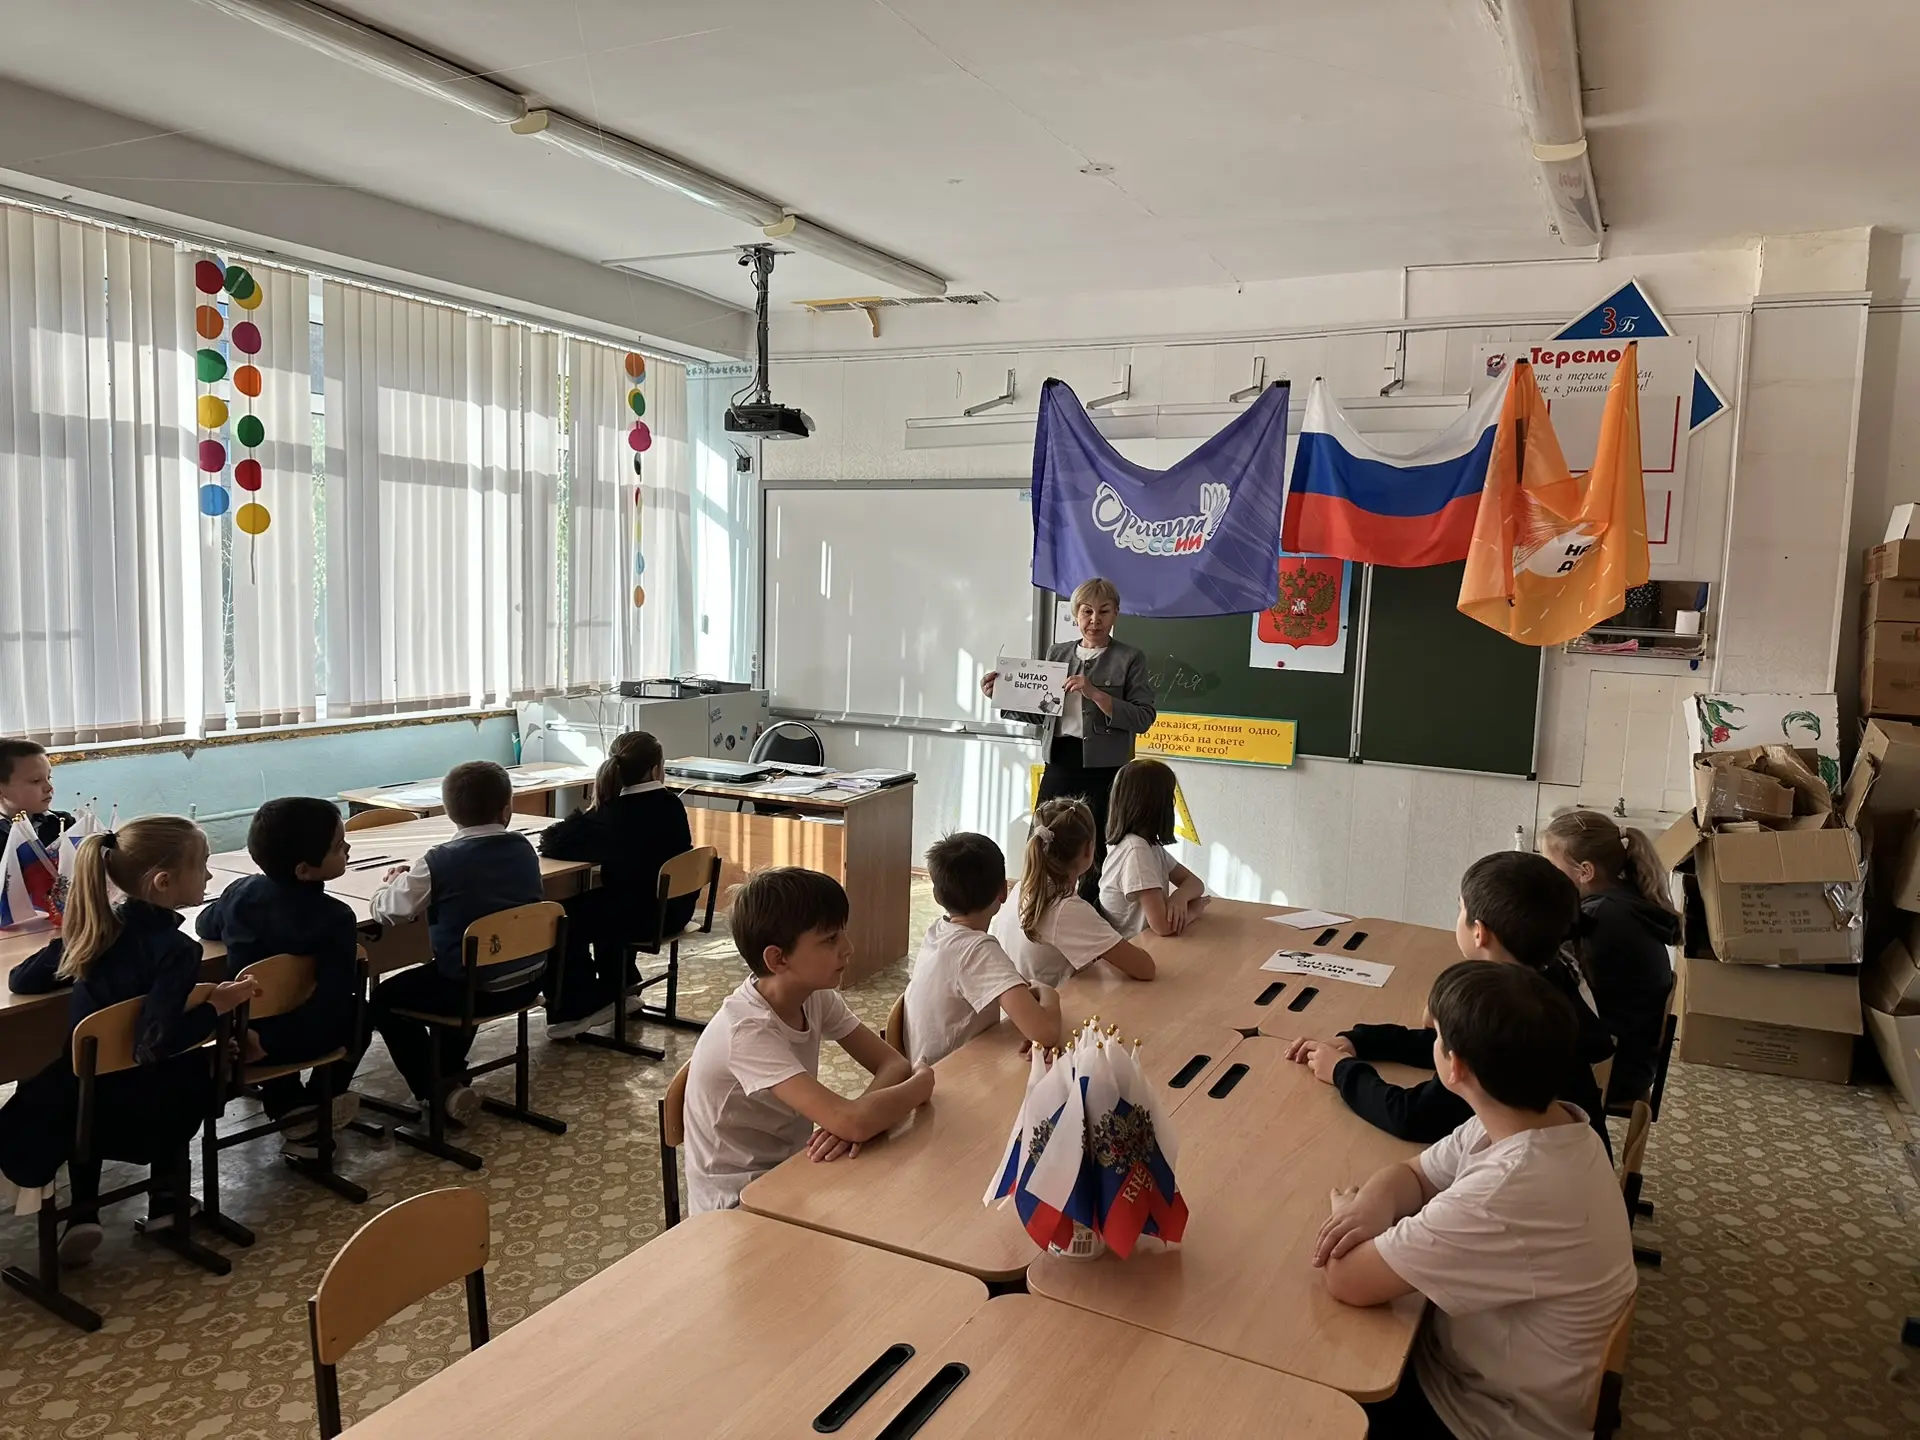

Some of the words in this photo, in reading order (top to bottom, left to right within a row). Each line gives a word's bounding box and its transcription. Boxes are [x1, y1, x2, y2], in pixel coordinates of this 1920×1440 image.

[1530, 347, 1621, 369] Теремо
[1018, 672, 1048, 682] ЧИТАЮ
[1014, 681, 1049, 691] БЫСТРО
[1152, 719, 1201, 732] лекайся,
[1203, 723, 1242, 733] помни
[1248, 727, 1281, 738] одно,
[1153, 732, 1195, 744] дружба
[1198, 736, 1211, 744] на
[1215, 739, 1245, 747] свете
[1147, 741, 1191, 752] дороже
[1196, 745, 1229, 755] всего!
